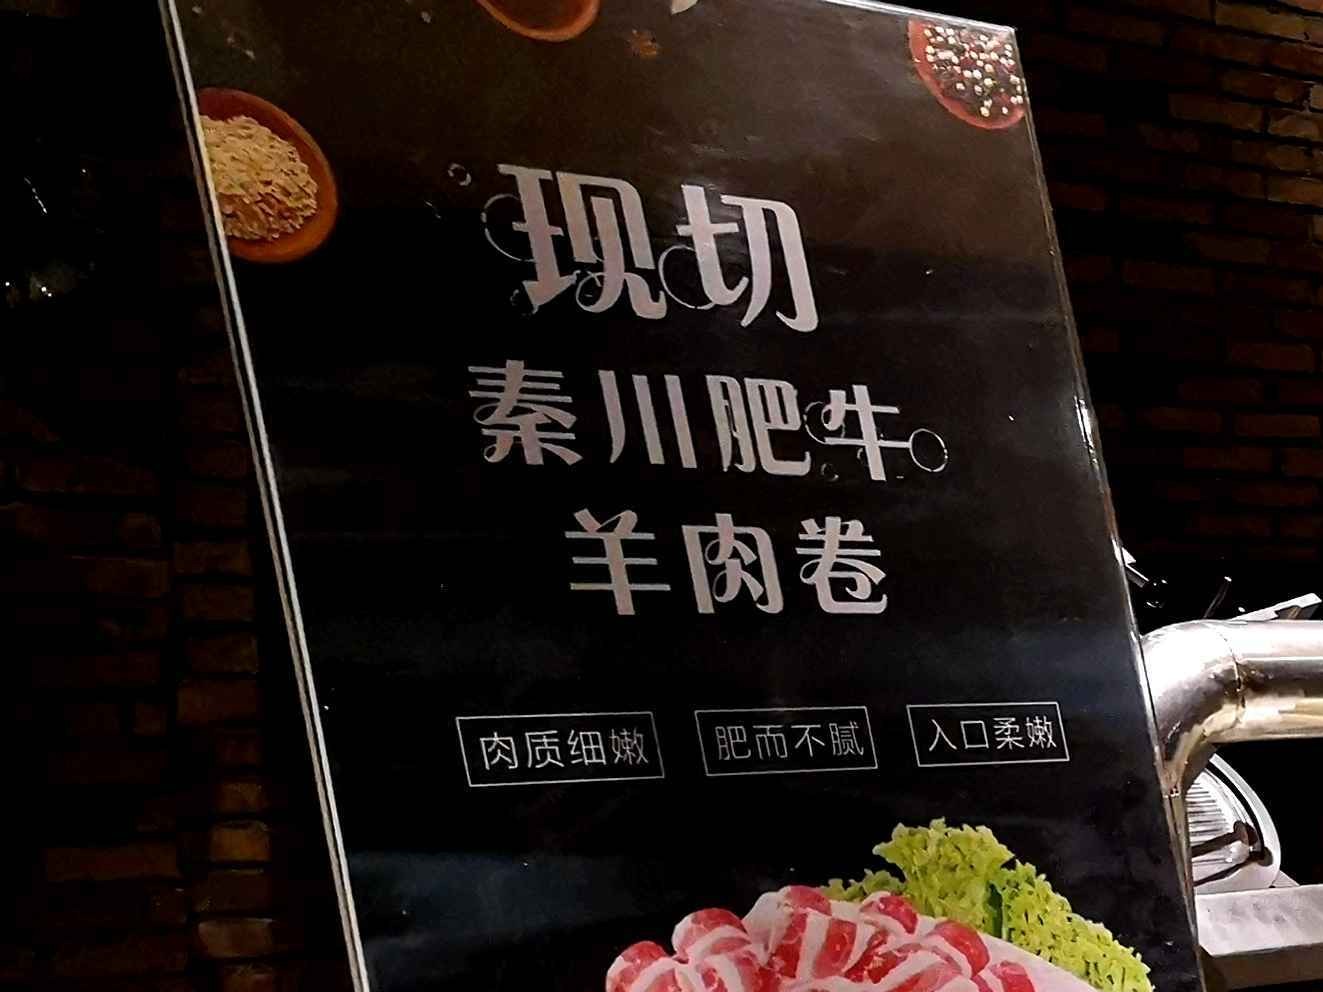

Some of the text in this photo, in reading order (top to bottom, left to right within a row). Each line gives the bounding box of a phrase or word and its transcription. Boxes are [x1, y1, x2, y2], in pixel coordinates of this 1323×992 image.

[482, 163, 819, 333] 现切
[468, 359, 948, 482] 秦川肥牛
[565, 508, 888, 617] 羊肉卷
[478, 727, 651, 770] 肉质细嫩
[715, 721, 866, 763] 肥而不腻
[927, 716, 1058, 753] 入口柔嫩
